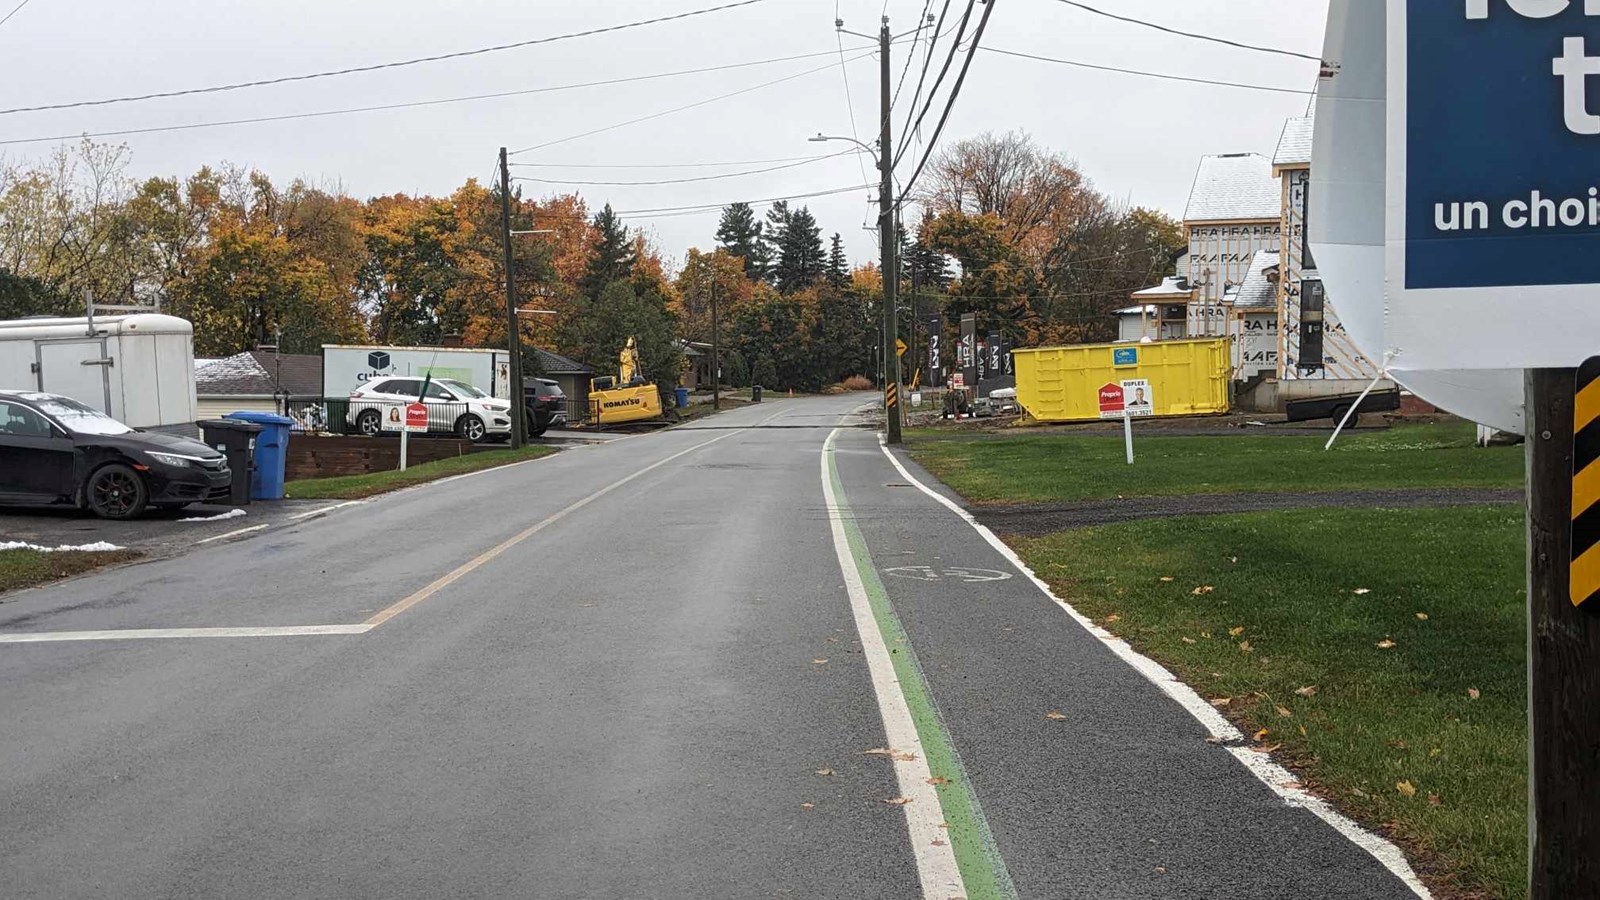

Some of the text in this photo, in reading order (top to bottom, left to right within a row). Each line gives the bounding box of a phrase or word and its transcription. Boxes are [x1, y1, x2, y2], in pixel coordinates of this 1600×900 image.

[1434, 186, 1600, 231] un choi
[962, 334, 971, 368] HRA
[603, 398, 640, 408] KOMATSU
